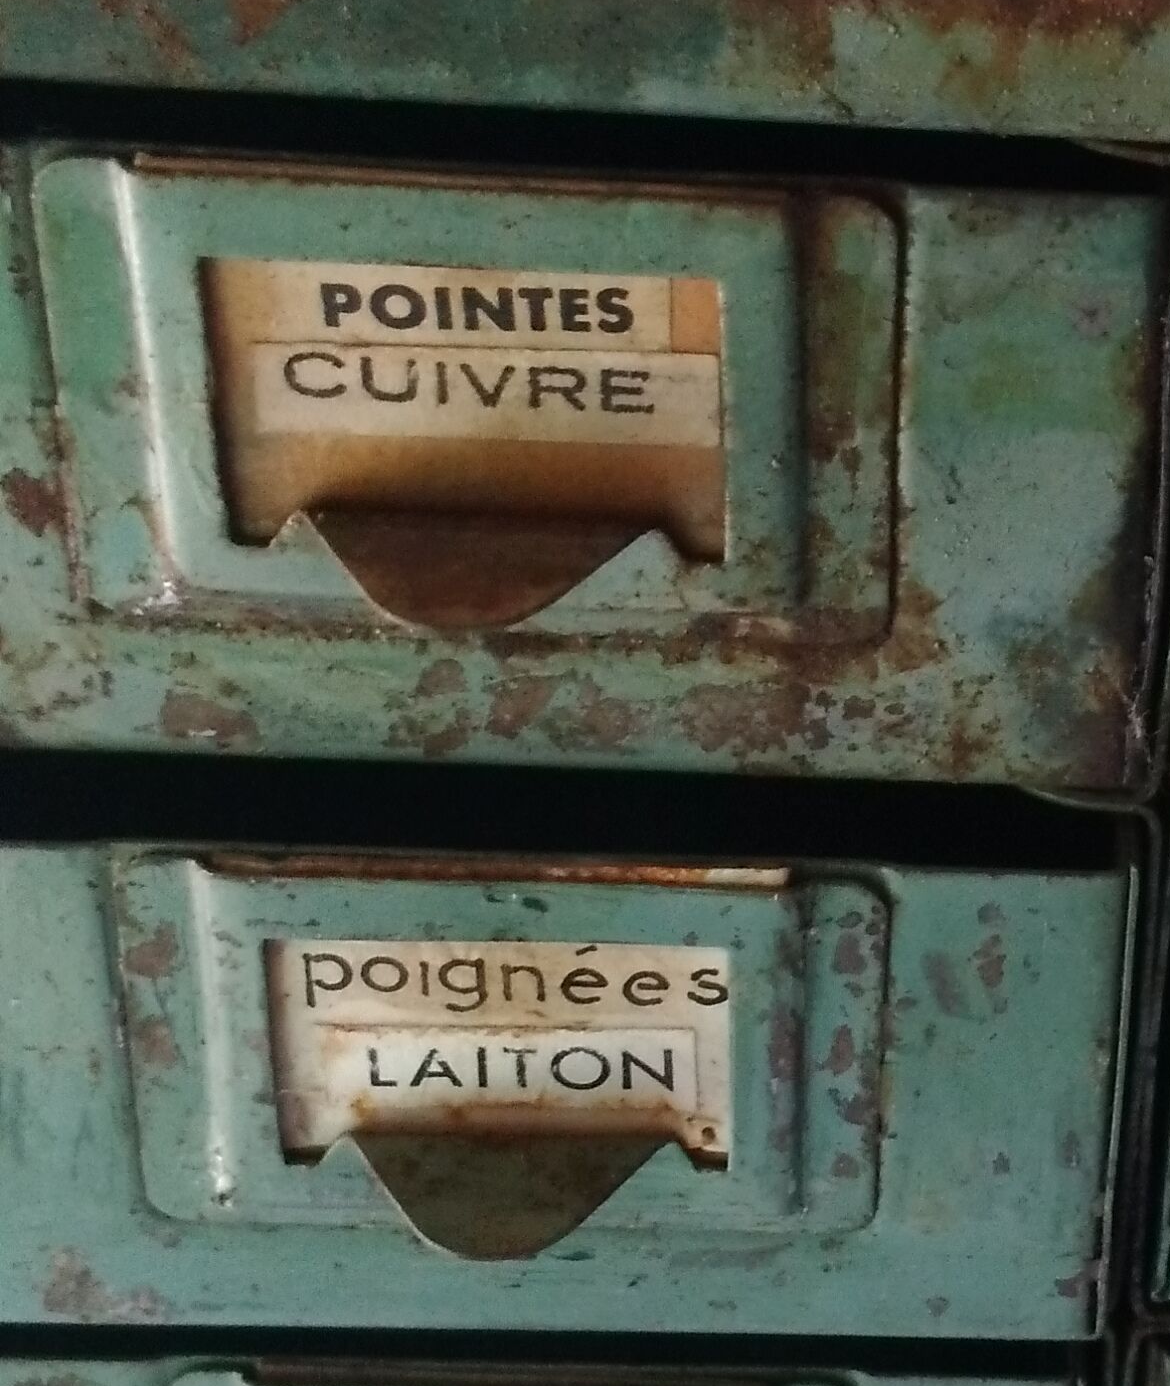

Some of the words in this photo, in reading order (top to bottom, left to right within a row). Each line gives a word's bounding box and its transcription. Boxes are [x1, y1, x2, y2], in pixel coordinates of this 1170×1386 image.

[320, 282, 634, 333] POINTES
[283, 351, 655, 413] CUIVRE
[302, 945, 729, 1012] poignées
[367, 1046, 676, 1092] LAITON
